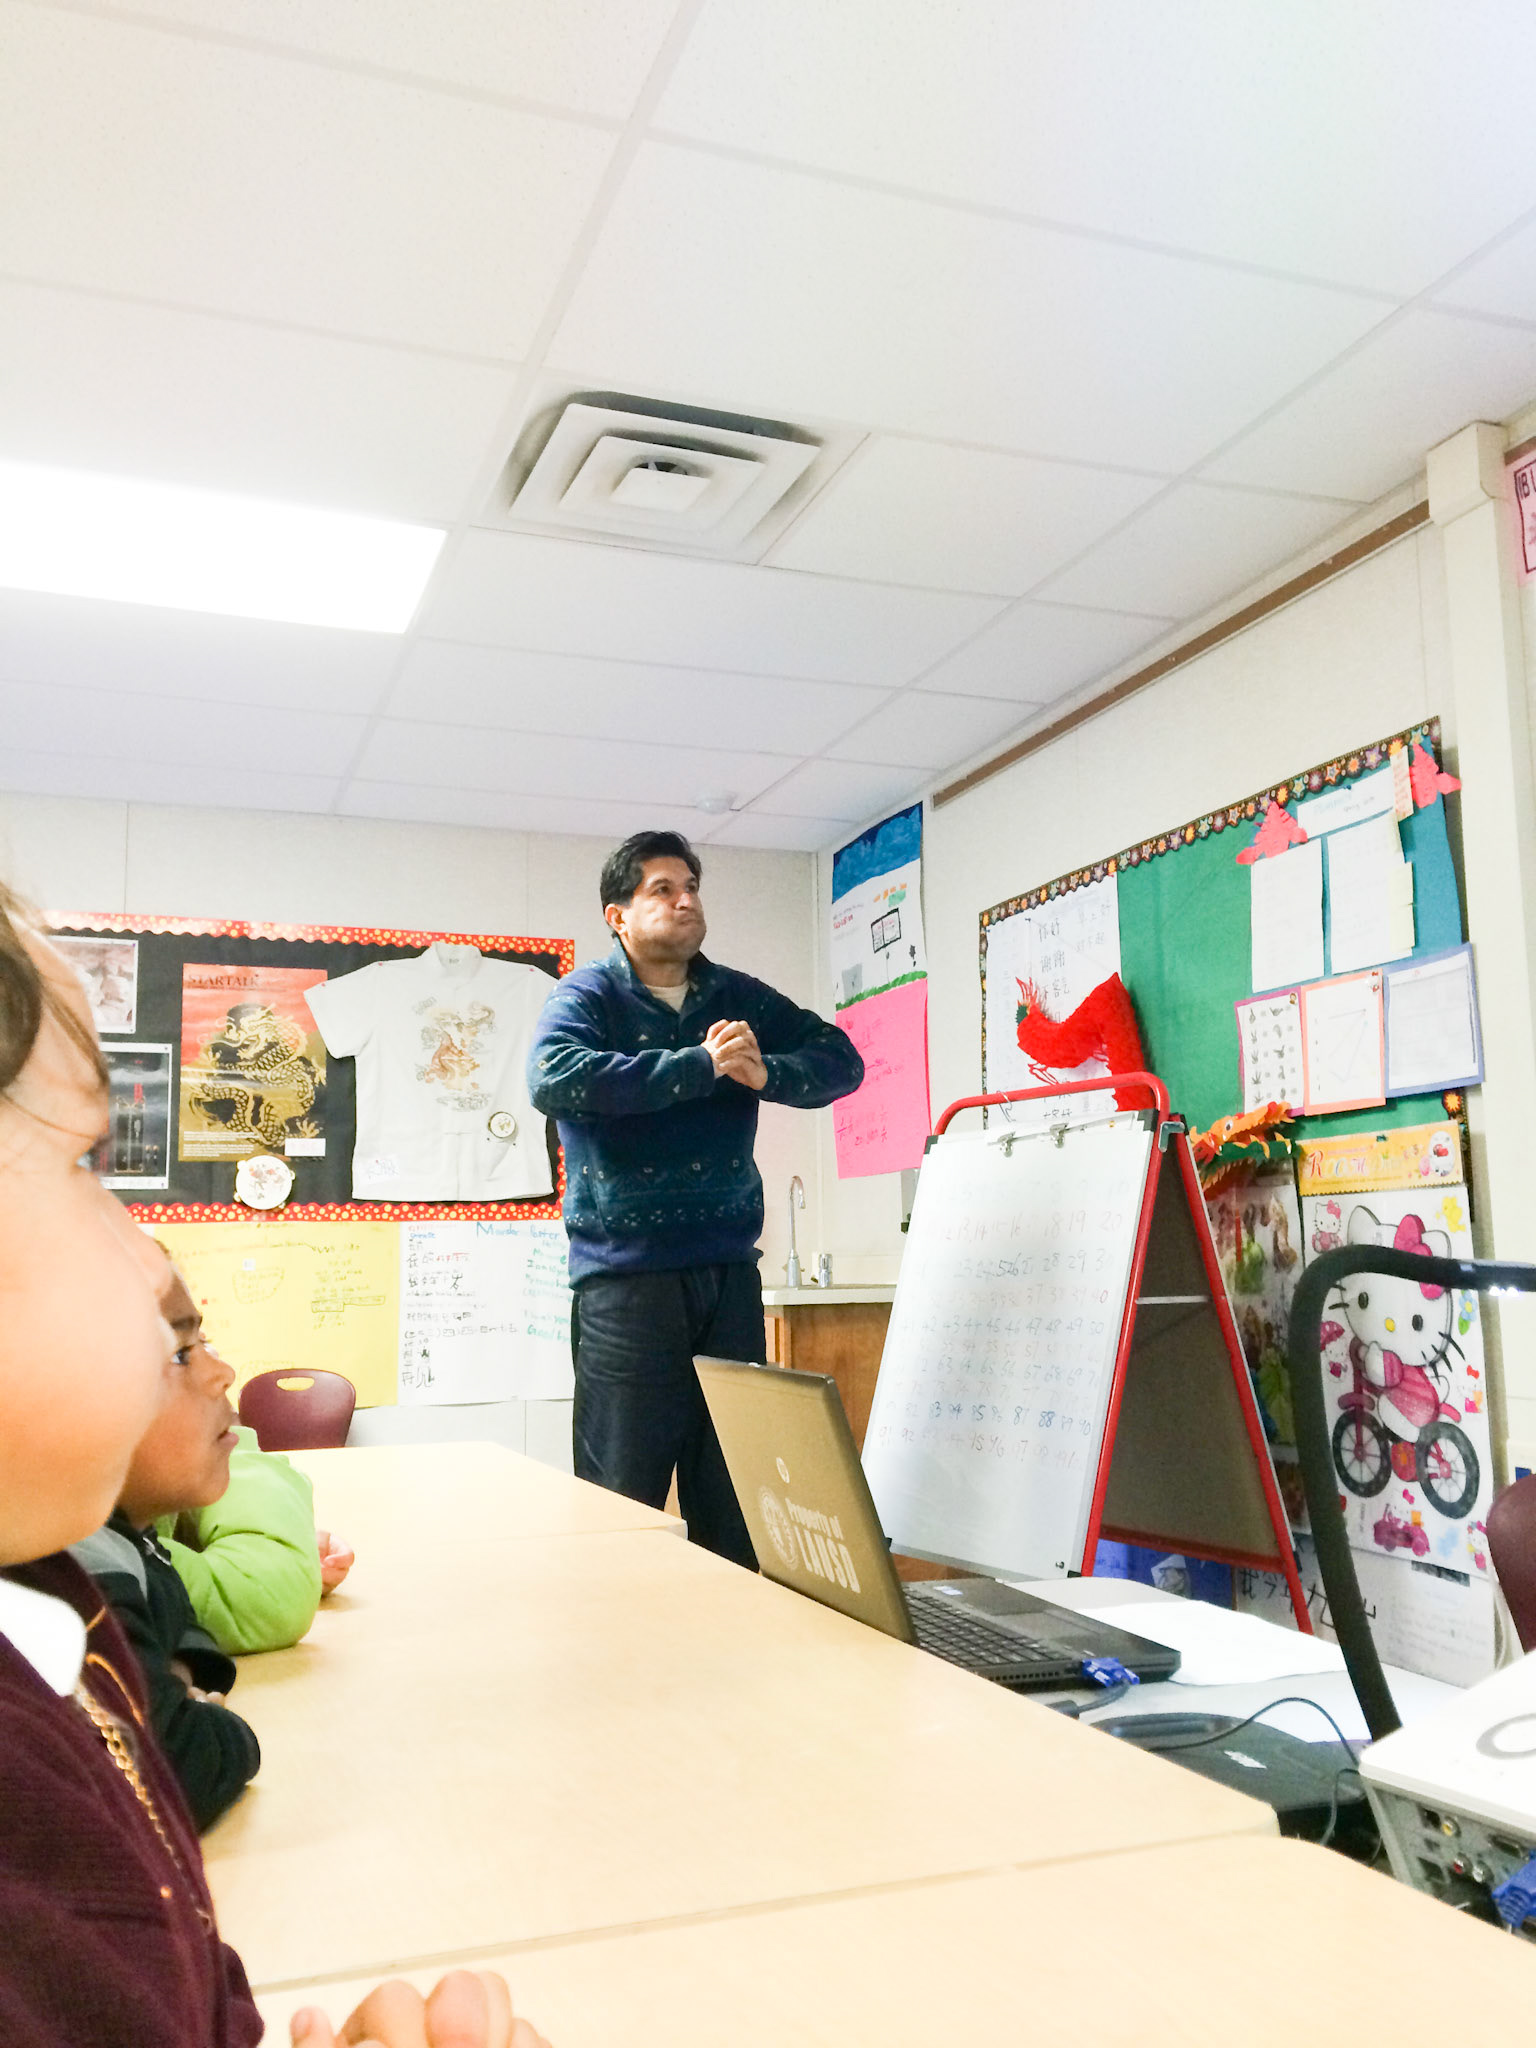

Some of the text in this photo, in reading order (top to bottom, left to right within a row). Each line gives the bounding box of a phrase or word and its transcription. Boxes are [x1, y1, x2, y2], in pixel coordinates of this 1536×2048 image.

[1038, 917, 1060, 943] 你好
[1040, 950, 1065, 973] 谢谢
[189, 974, 259, 988] STARTALK
[1068, 1209, 1087, 1233] 19
[1099, 1210, 1123, 1232] 20
[1042, 1252, 1060, 1273] 28
[1067, 1248, 1087, 1273] 29
[942, 1315, 961, 1335] 43
[963, 1317, 982, 1335] 44
[985, 1316, 1001, 1334] 45
[1005, 1318, 1021, 1337] 46
[1025, 1316, 1043, 1336] 47
[1044, 1317, 1062, 1335] 48
[1066, 1316, 1084, 1335] 49
[402, 1366, 435, 1389] 再见
[980, 1358, 995, 1376] 65
[1066, 1366, 1084, 1387] 69
[1037, 1410, 1056, 1428] 88
[784, 1497, 845, 1541] Property of
[794, 1525, 861, 1594] LAUSD
